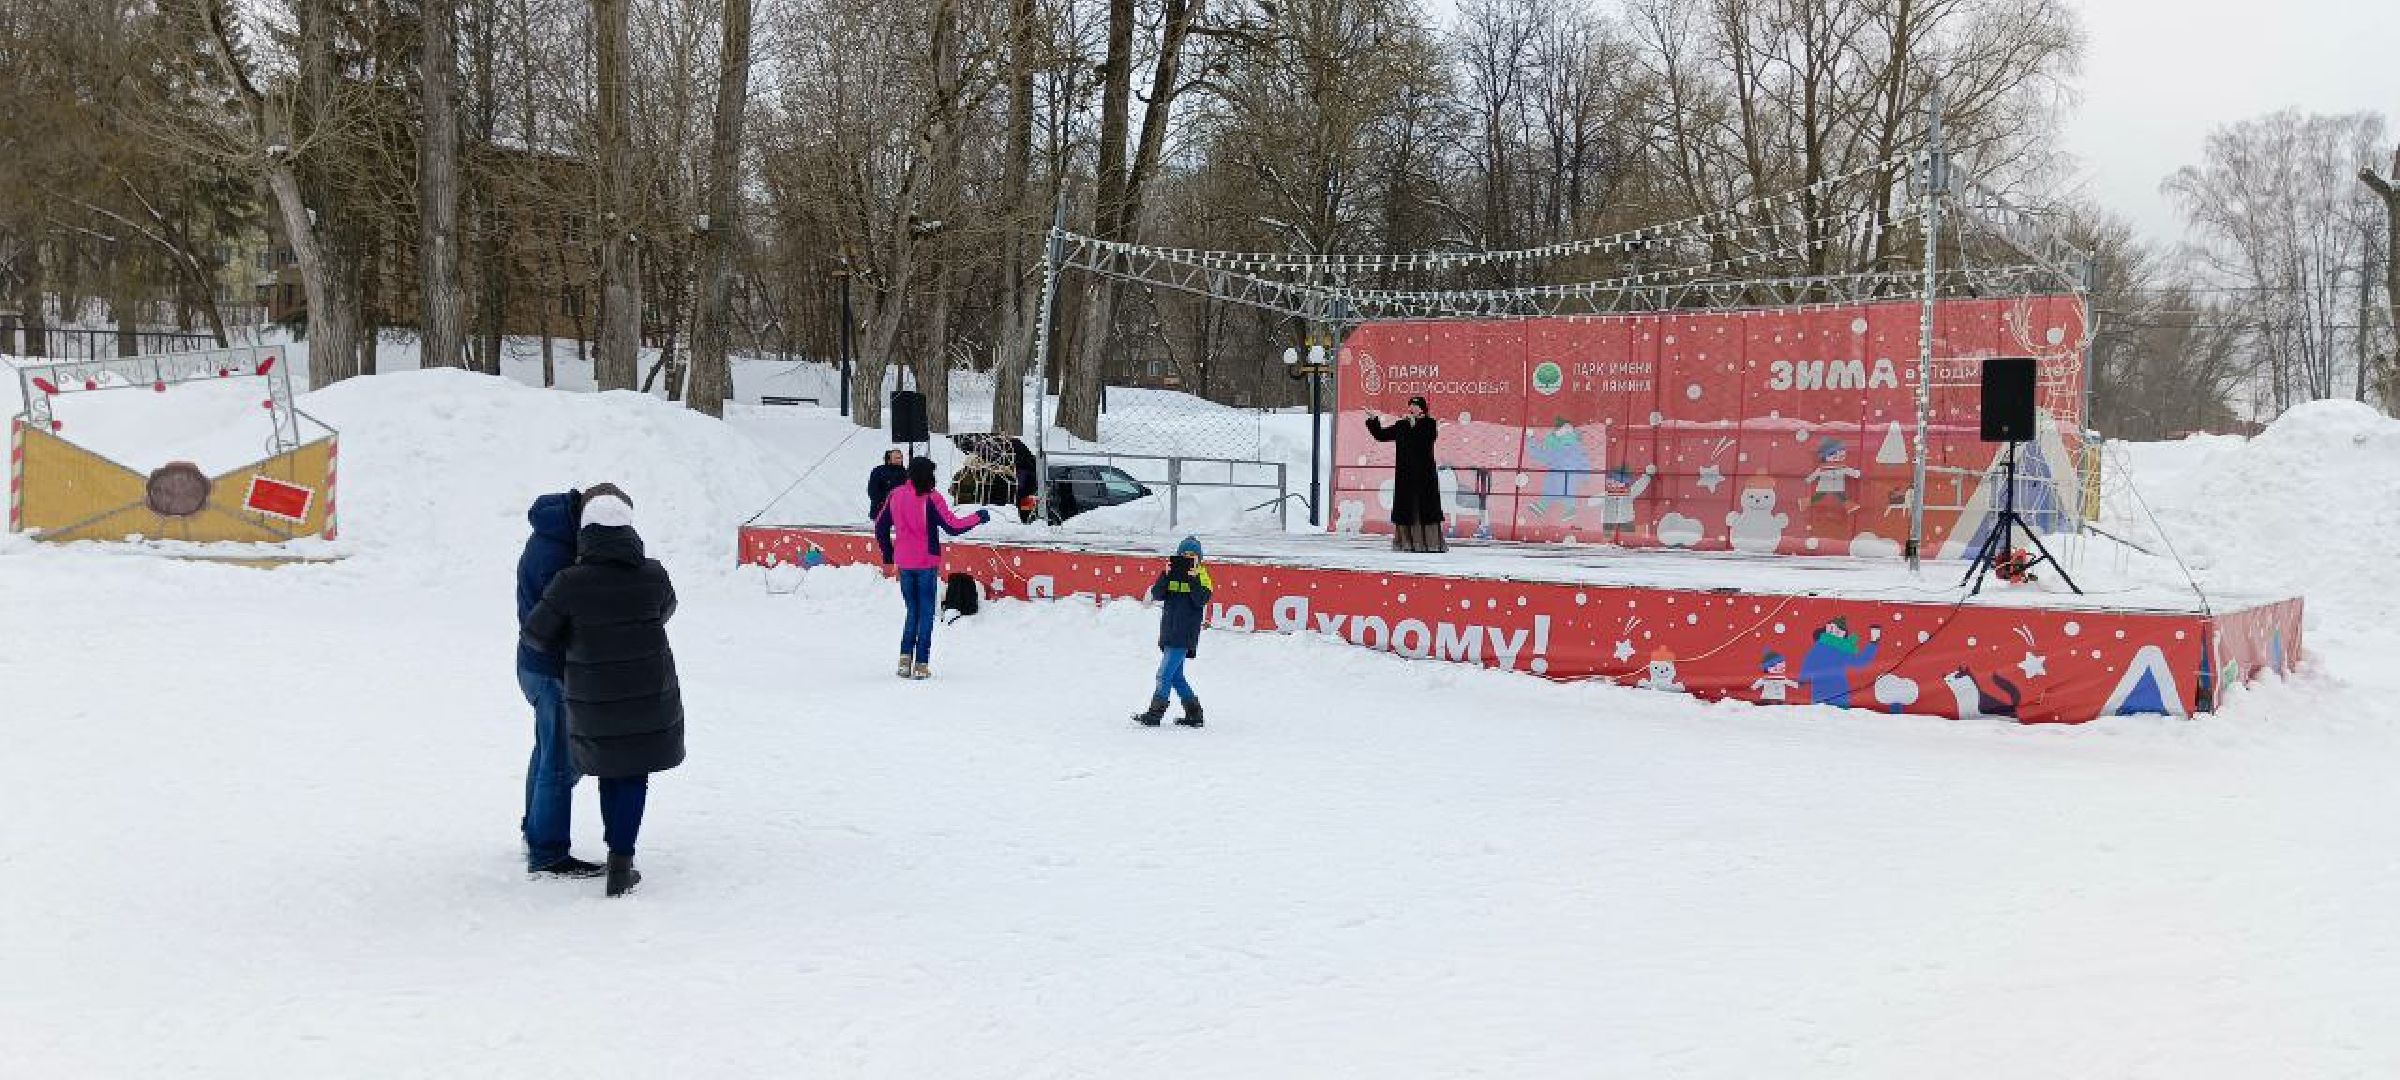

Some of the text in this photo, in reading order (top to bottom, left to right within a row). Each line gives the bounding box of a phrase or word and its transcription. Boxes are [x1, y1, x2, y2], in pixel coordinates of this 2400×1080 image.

[1388, 364, 1439, 379] ПАРКИ
[1573, 361, 1652, 376] ПАРК ИМЕНИ
[1770, 358, 1898, 390] ЗИМА
